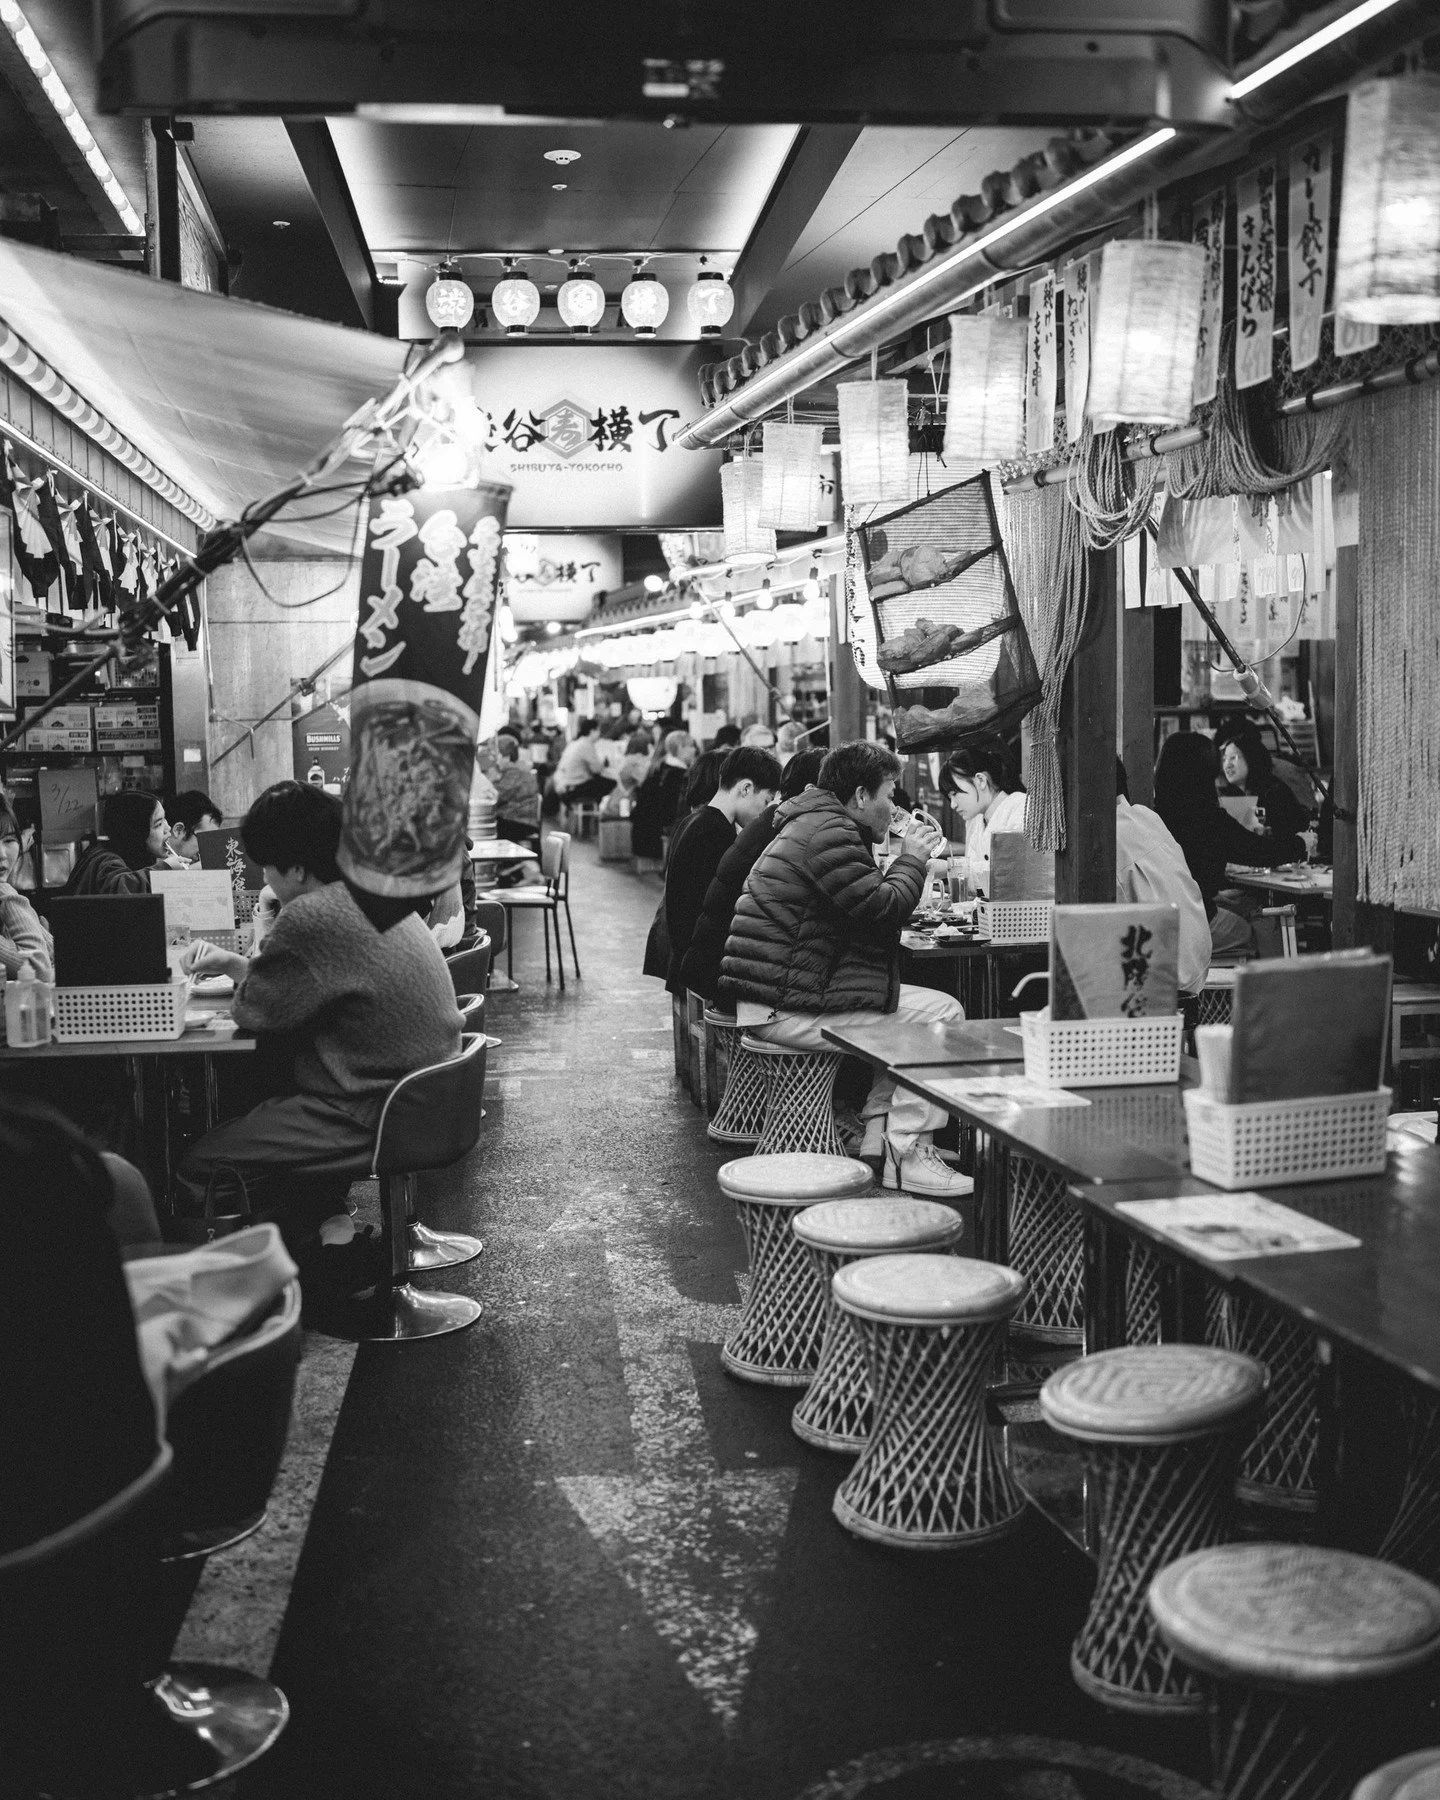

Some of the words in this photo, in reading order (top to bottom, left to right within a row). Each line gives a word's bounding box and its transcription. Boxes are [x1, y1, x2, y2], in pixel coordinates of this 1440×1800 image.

[1240, 214, 1258, 340] きんぴら
[510, 462, 623, 473] SHIBUYA-YOKOCHO
[359, 498, 419, 678] ラーメン
[306, 735, 341, 743] BUSHMILLS
